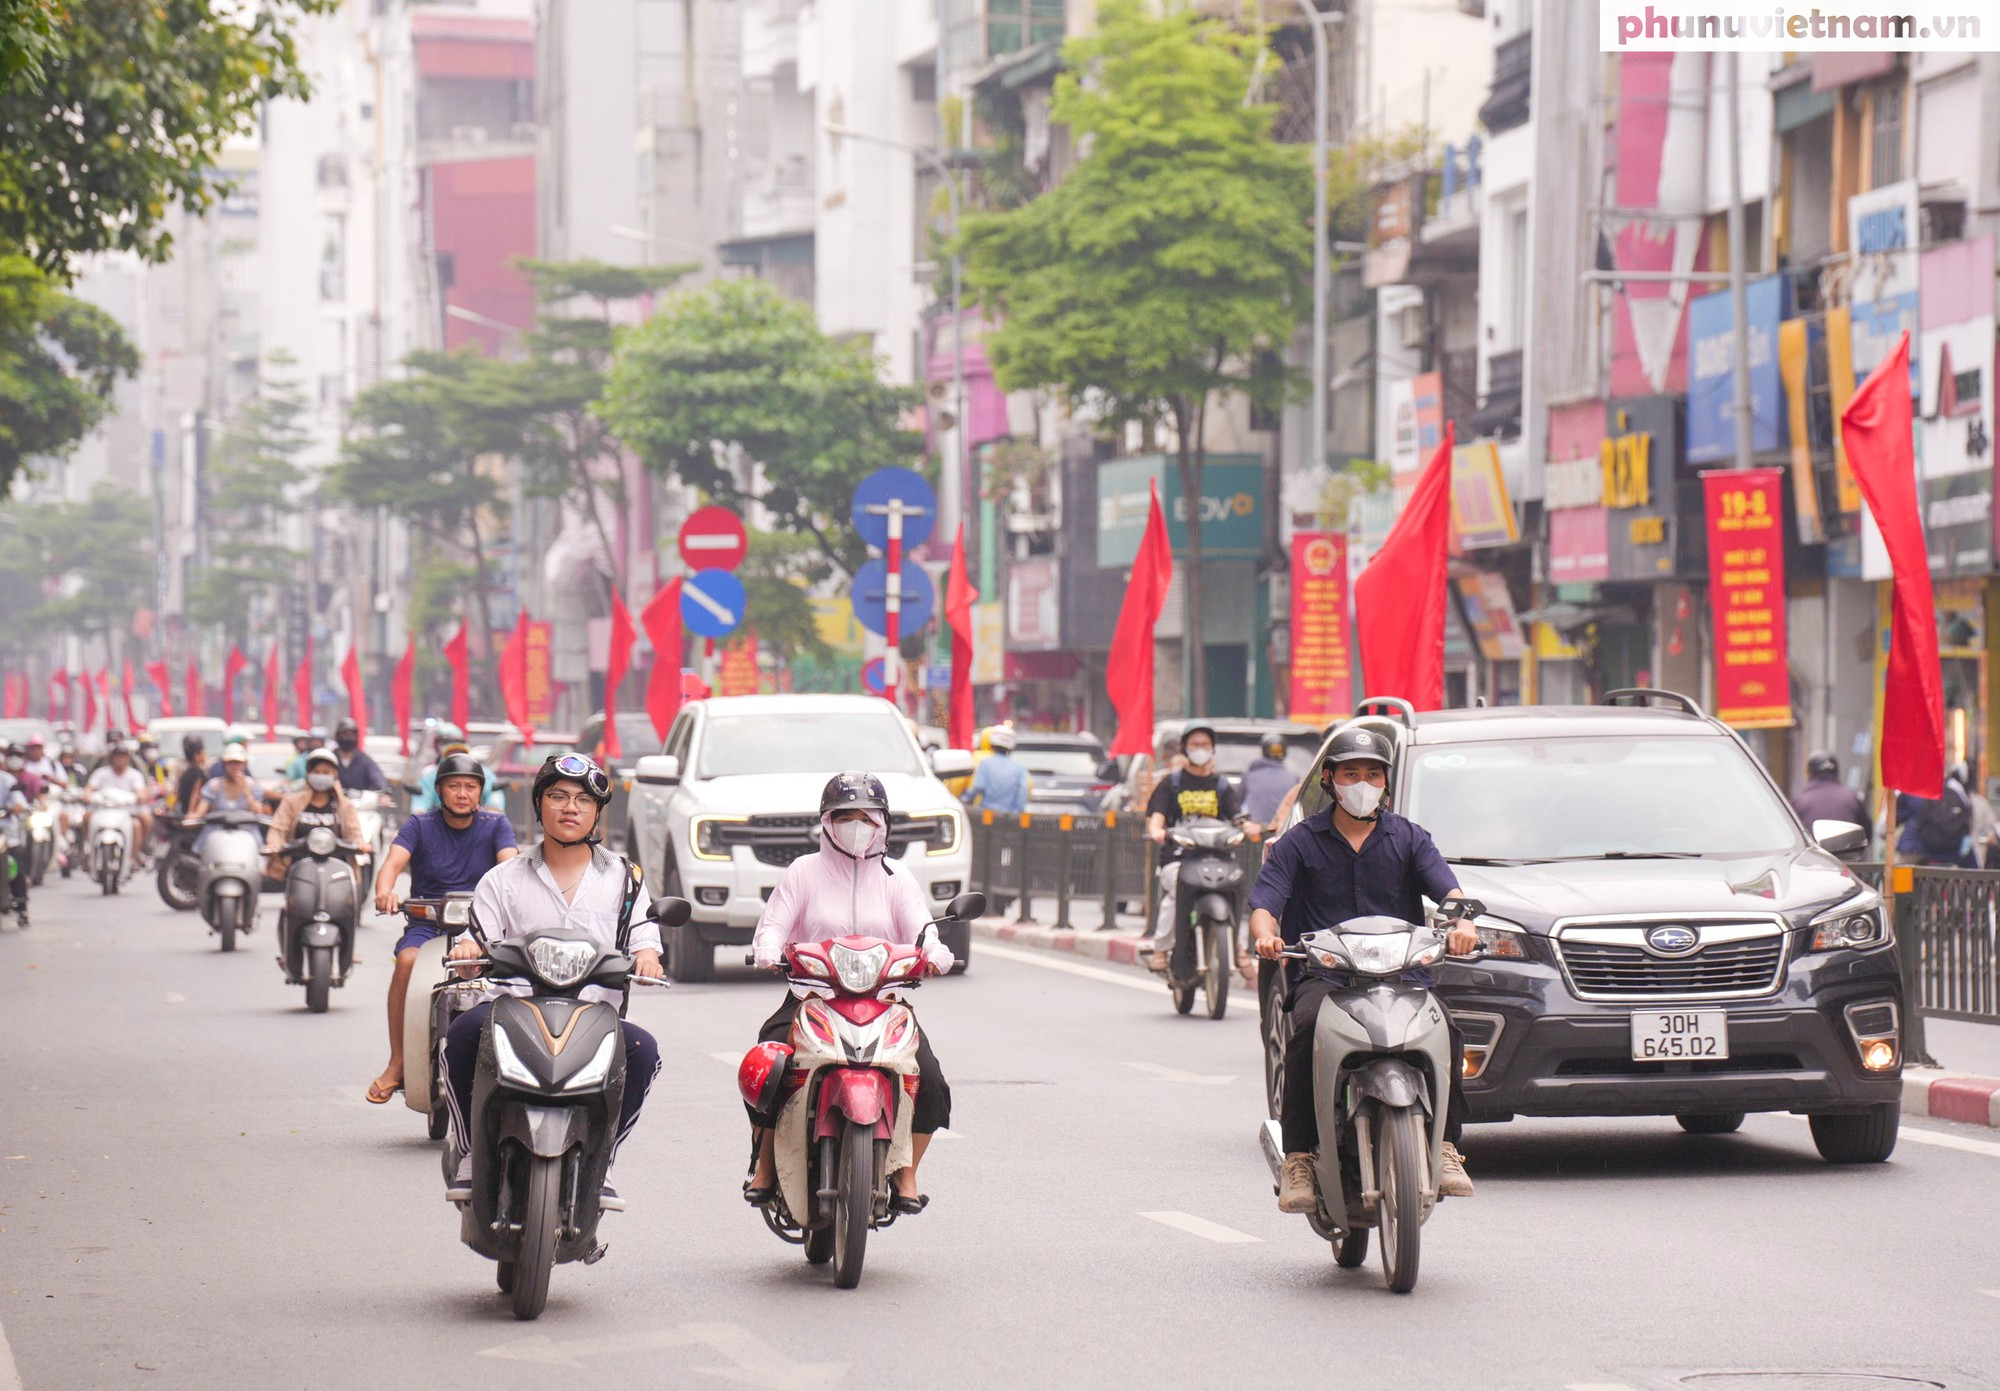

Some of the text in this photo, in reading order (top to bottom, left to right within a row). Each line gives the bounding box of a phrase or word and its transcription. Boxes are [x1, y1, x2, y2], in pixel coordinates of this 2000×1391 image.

[1173, 496, 1233, 522] BDV
[1659, 1014, 1699, 1034] 30H
[1643, 1036, 1716, 1057] 645.02
